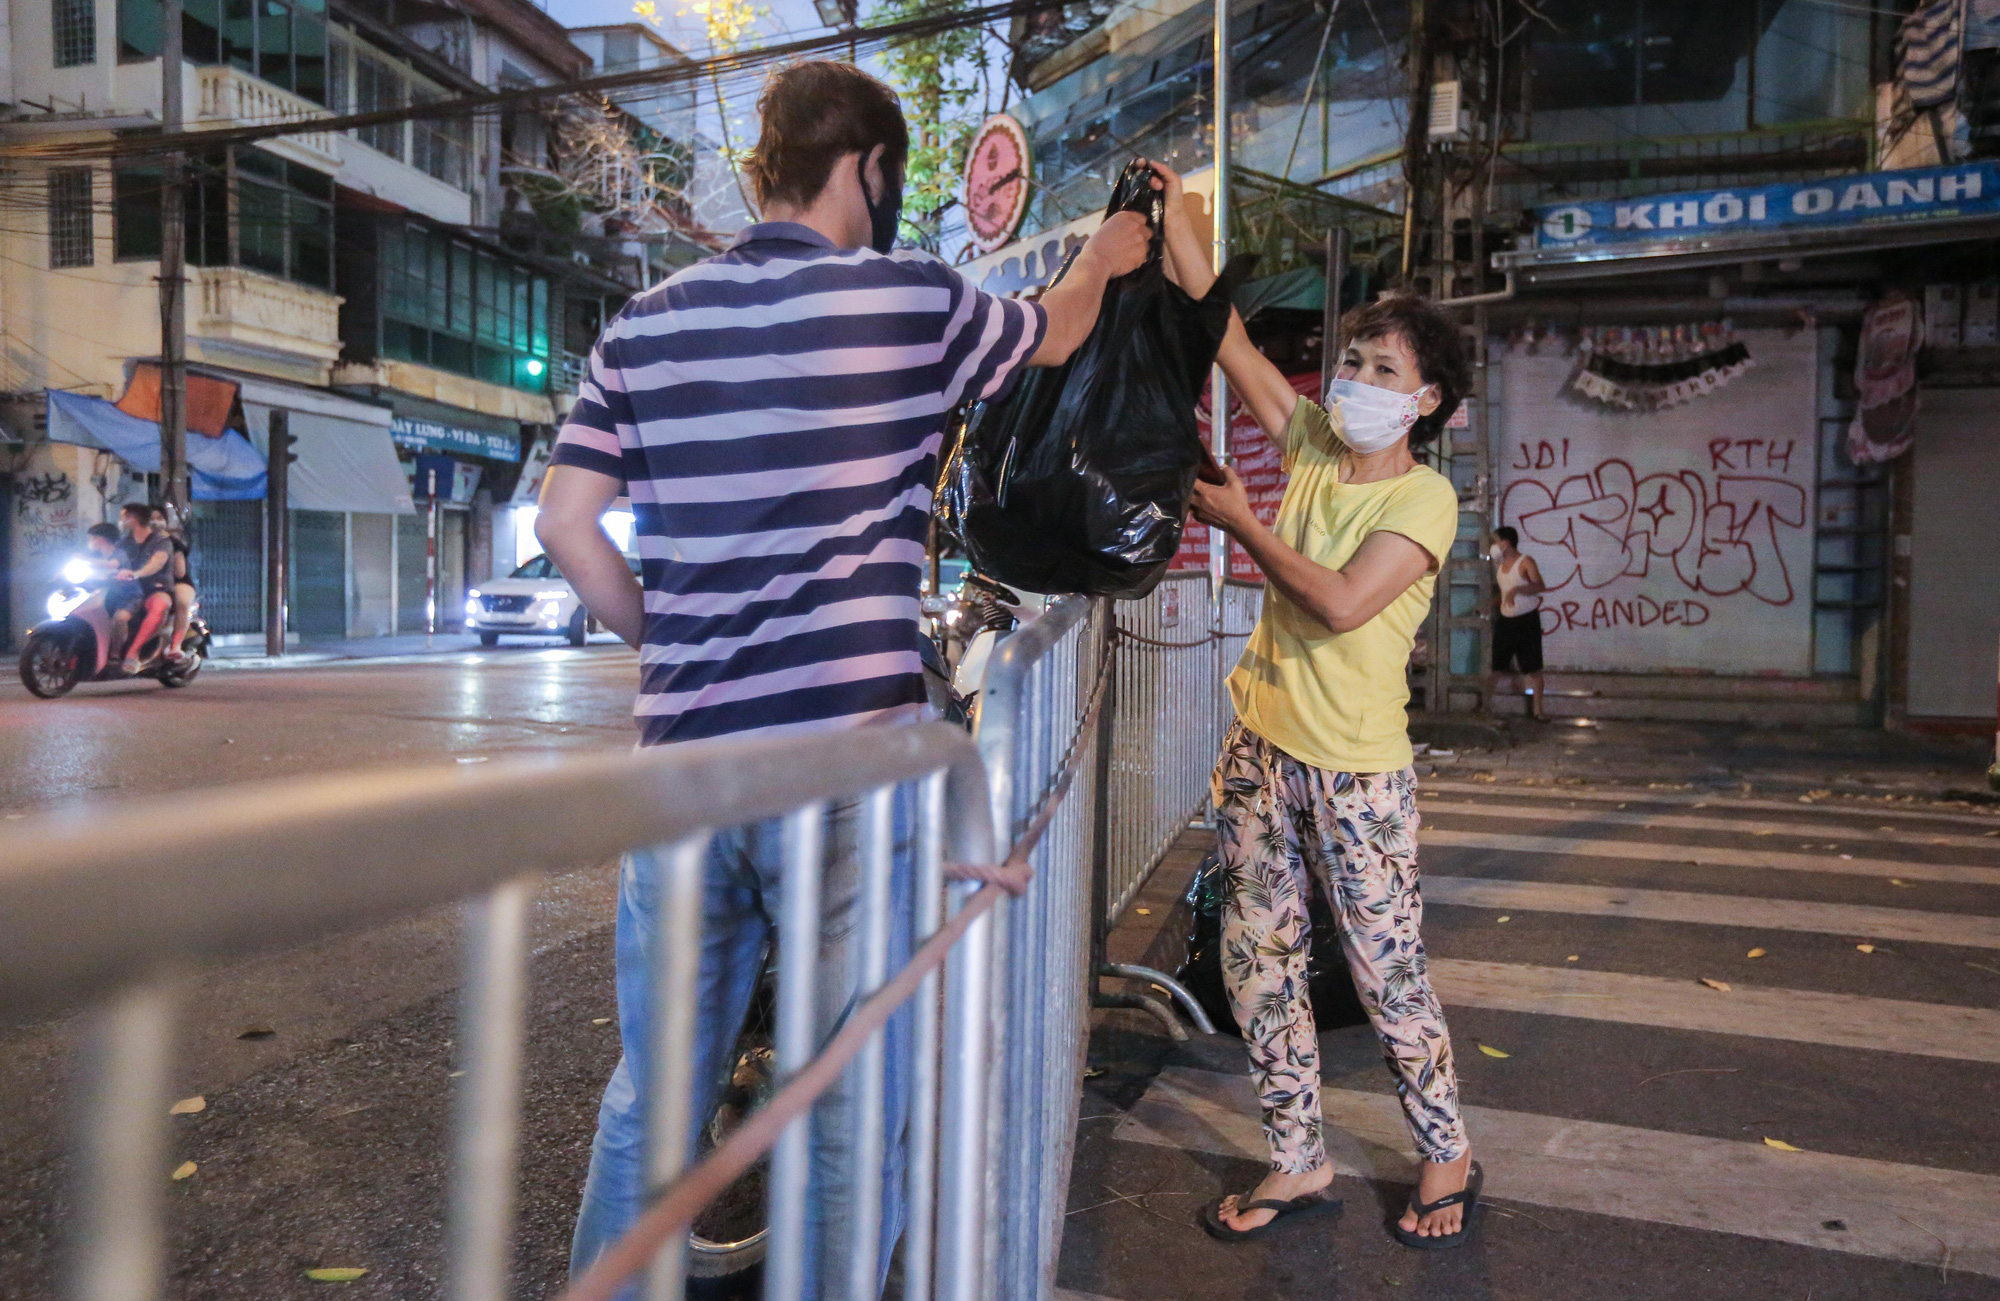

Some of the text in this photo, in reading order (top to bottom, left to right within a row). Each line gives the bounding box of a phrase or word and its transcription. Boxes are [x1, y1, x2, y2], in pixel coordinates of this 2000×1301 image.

[1615, 193, 1767, 230] KHÔI
[1792, 172, 1983, 216] OANH
[1708, 437, 1795, 473] RTH
[1306, 515, 1326, 537] ANGO
